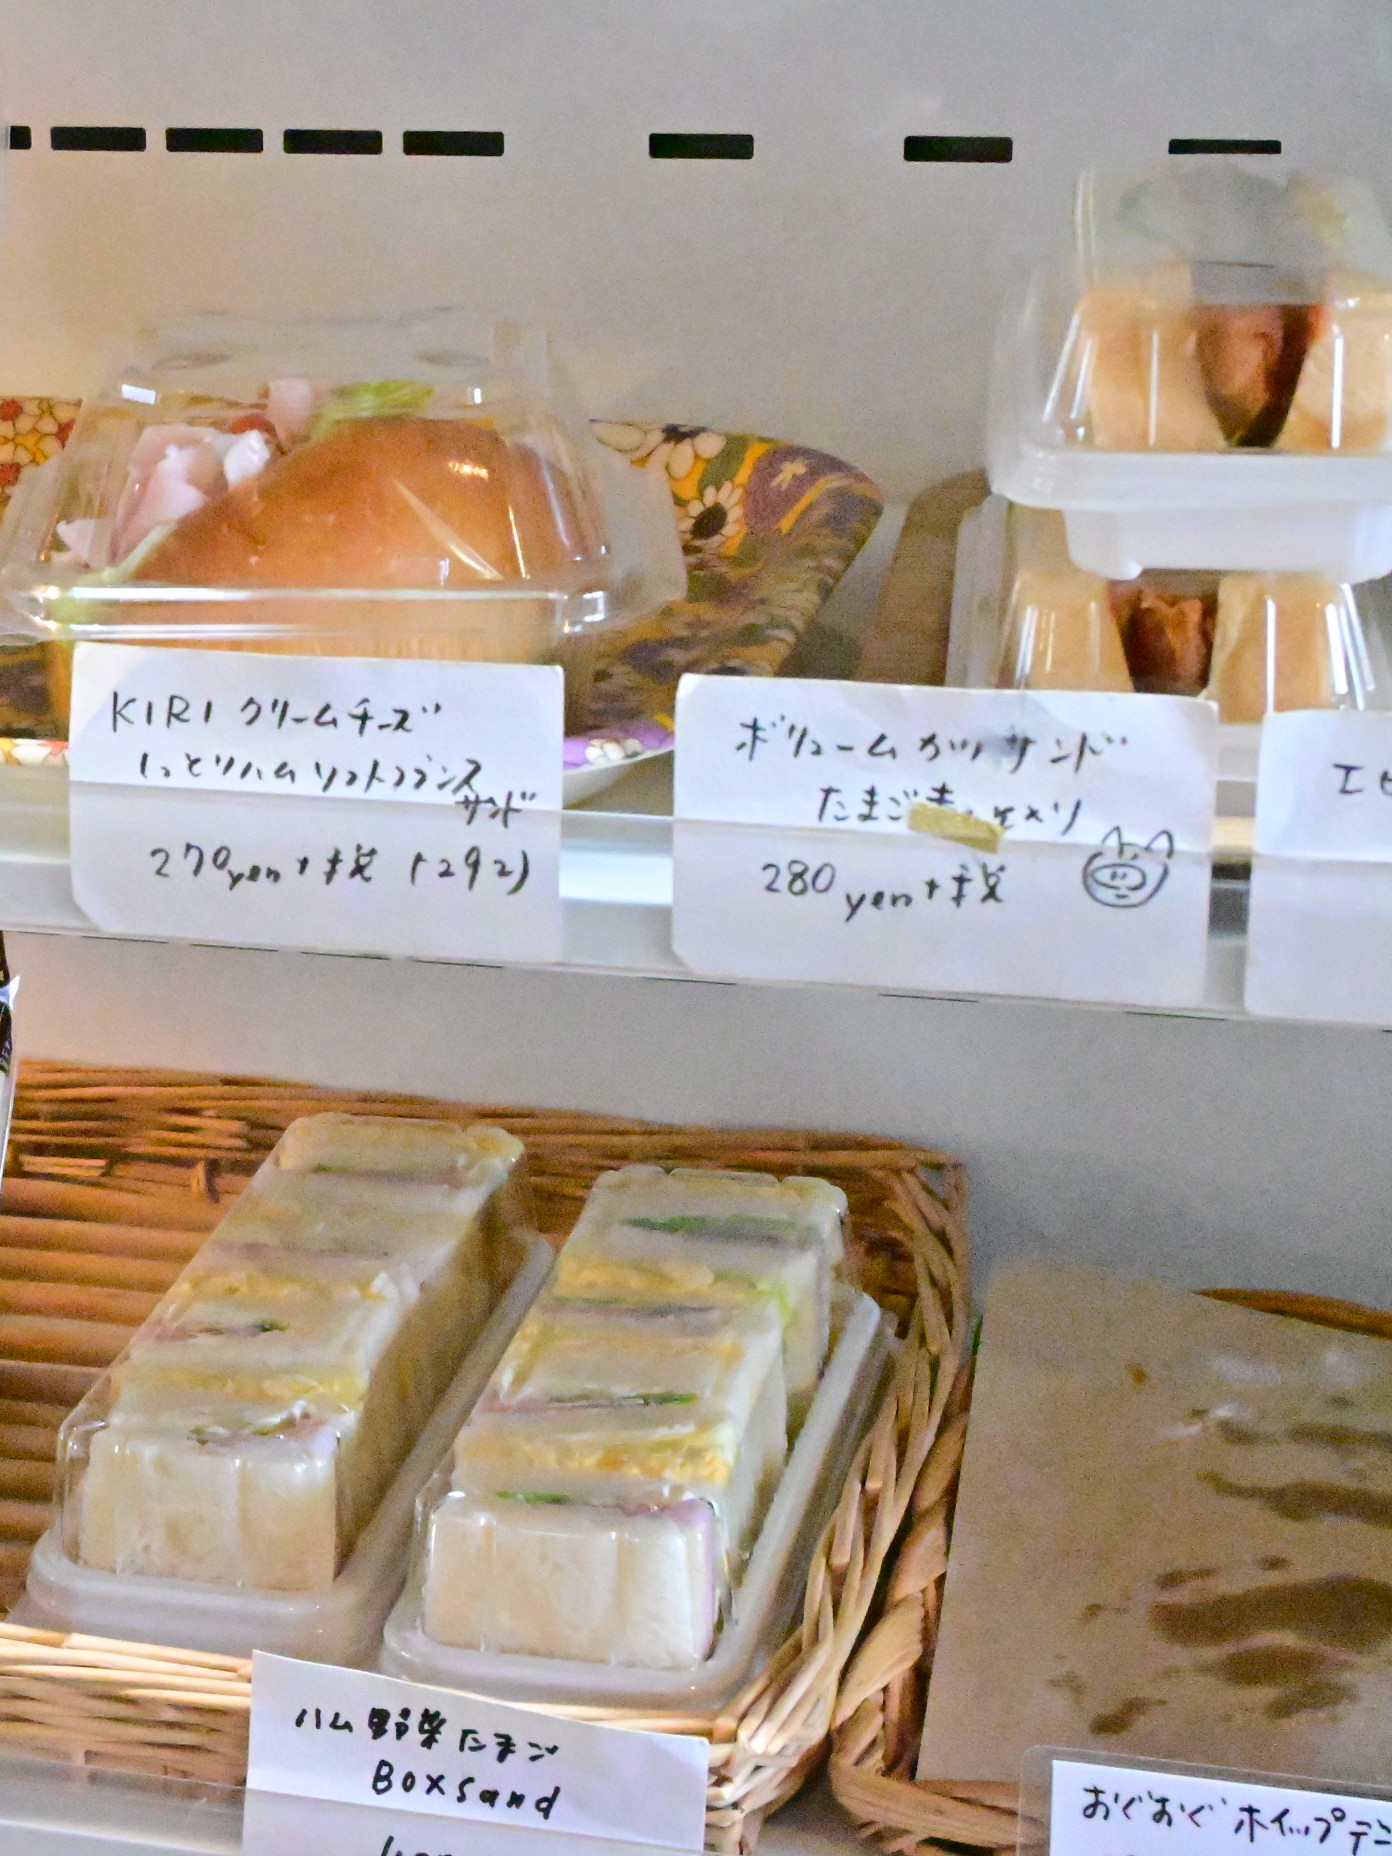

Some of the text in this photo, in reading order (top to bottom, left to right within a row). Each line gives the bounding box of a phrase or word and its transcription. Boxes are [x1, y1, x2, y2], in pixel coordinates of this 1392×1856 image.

[110, 691, 443, 737] KIRI クリームチーズ
